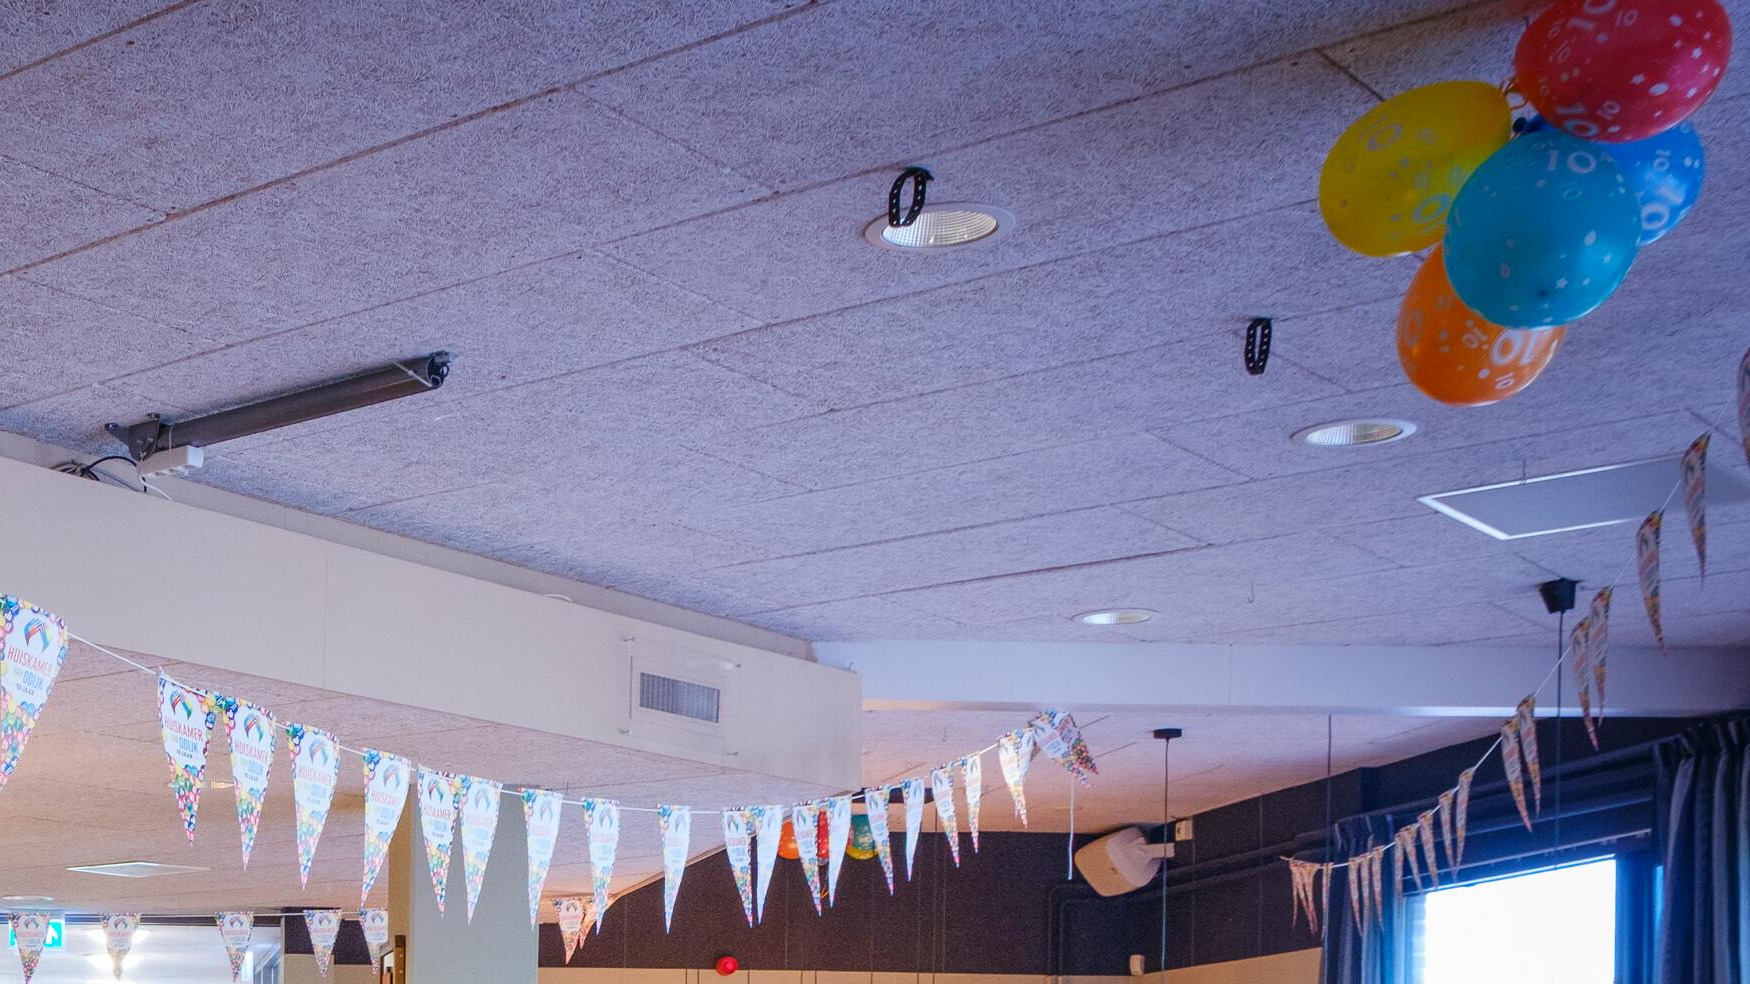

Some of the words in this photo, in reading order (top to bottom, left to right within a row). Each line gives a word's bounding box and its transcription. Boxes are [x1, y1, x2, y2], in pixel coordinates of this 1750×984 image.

[1548, 150, 1597, 174] 10
[8, 646, 52, 676] HUISKAMER
[164, 720, 203, 741] HUISKAMER
